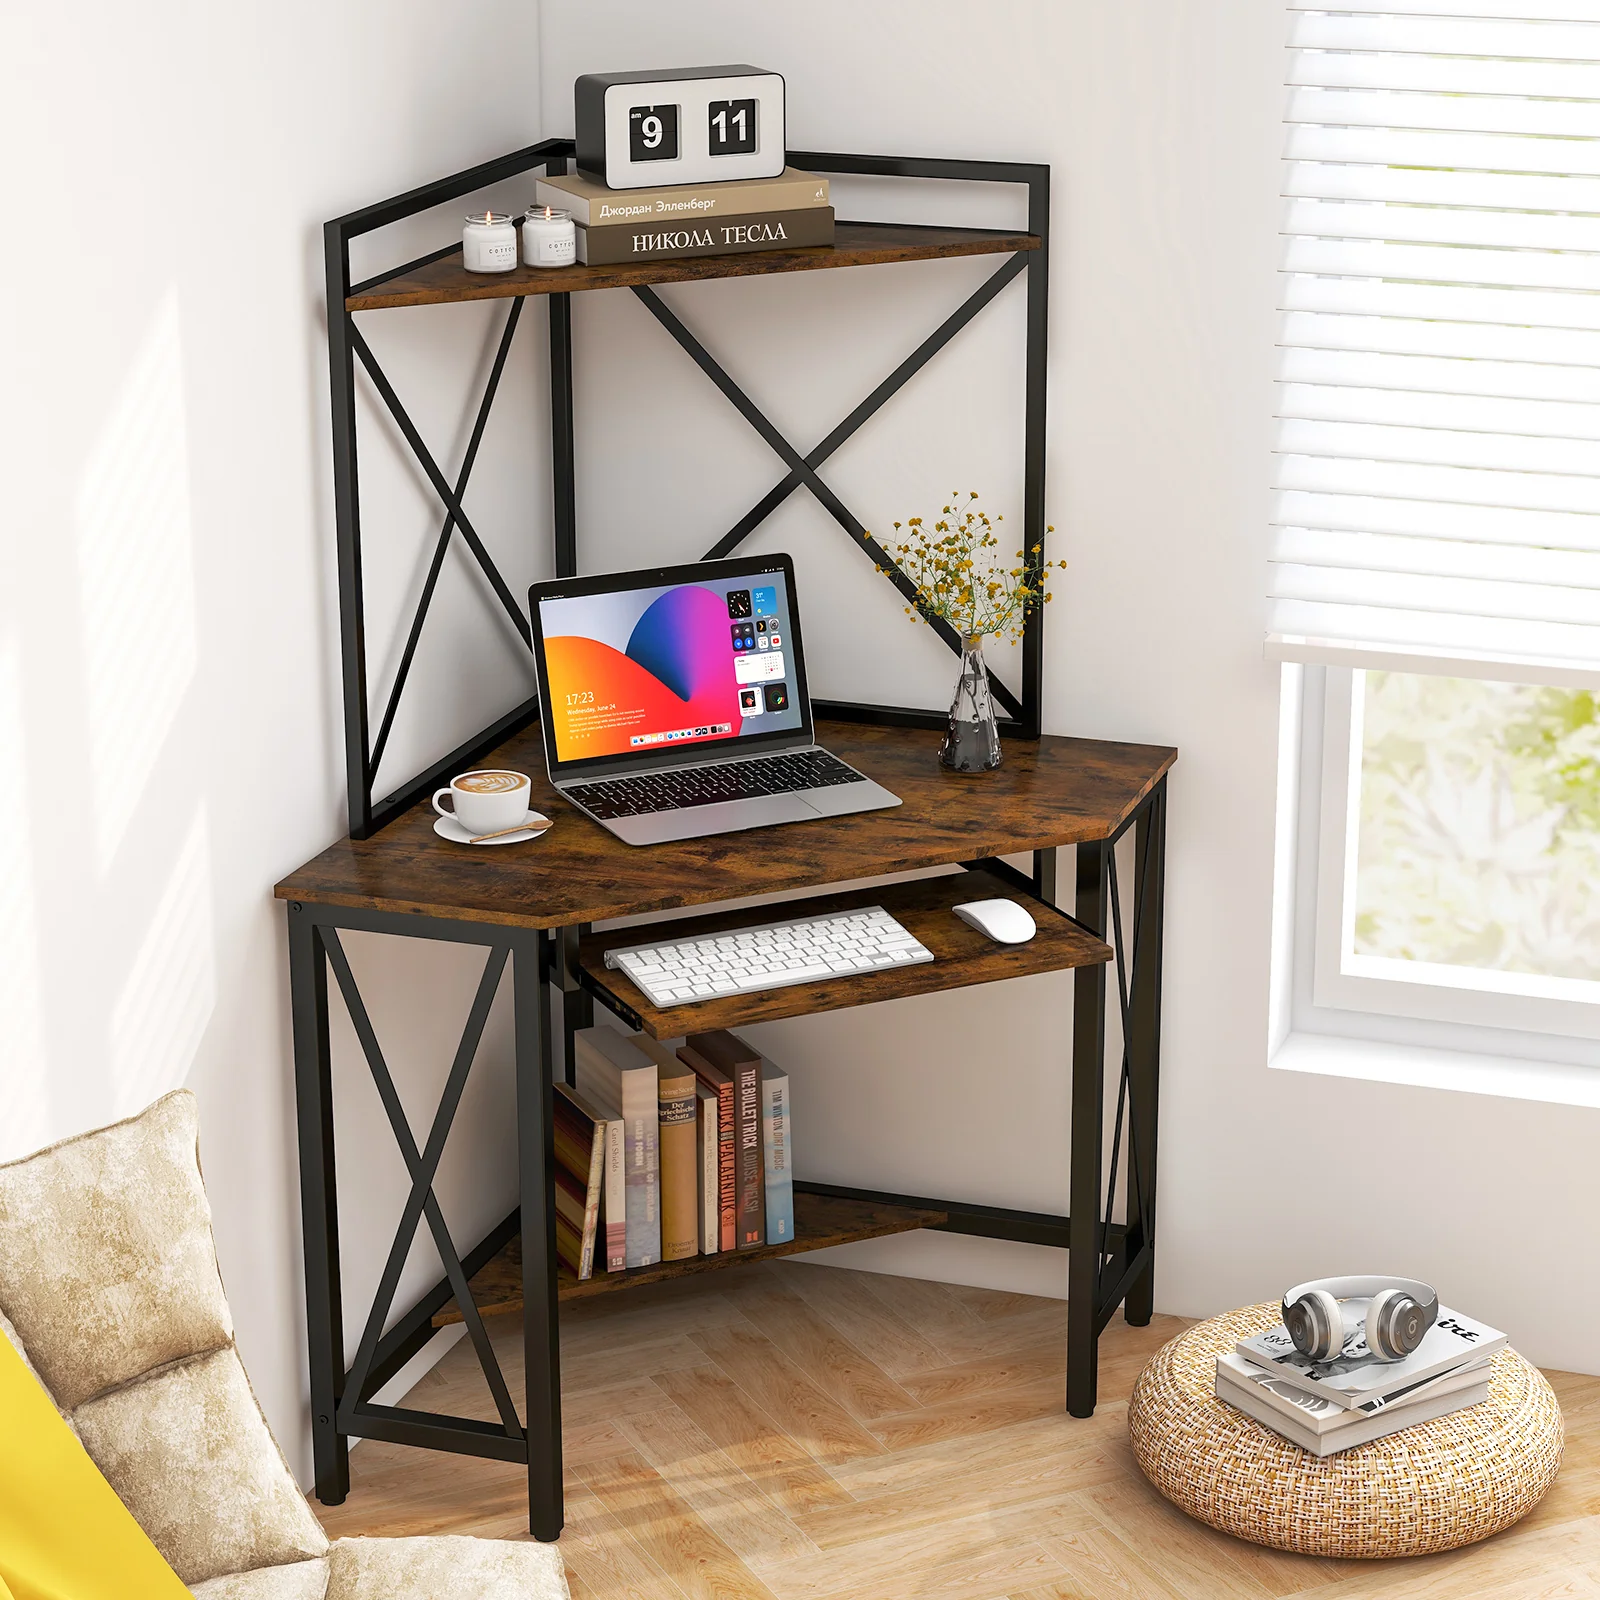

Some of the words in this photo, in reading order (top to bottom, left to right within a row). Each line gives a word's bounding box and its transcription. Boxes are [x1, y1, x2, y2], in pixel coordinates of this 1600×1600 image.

[641, 115, 664, 149] 9
[711, 108, 748, 143] 11
[599, 204, 652, 218] Джордан
[655, 198, 716, 214] Элленберг
[632, 230, 716, 253] НИКОЛА
[720, 222, 788, 245] ТЕСЛА
[565, 691, 595, 706] 17:23
[741, 1069, 757, 1088] THE
[720, 1087, 735, 1129] CHUCK
[741, 1088, 757, 1120] BULLET
[772, 1089, 783, 1103] TIM
[666, 1113, 690, 1121] Schatz
[772, 1103, 784, 1131] WINTON
[611, 1127, 619, 1147] Carol
[742, 1120, 758, 1149] TRICK
[773, 1132, 784, 1147] DIRT
[611, 1148, 620, 1173] Shields
[743, 1149, 758, 1182] LOUISE
[773, 1149, 785, 1171] MUSIC
[720, 1143, 736, 1213] PALAHNIUK
[743, 1182, 759, 1213] WELSH
